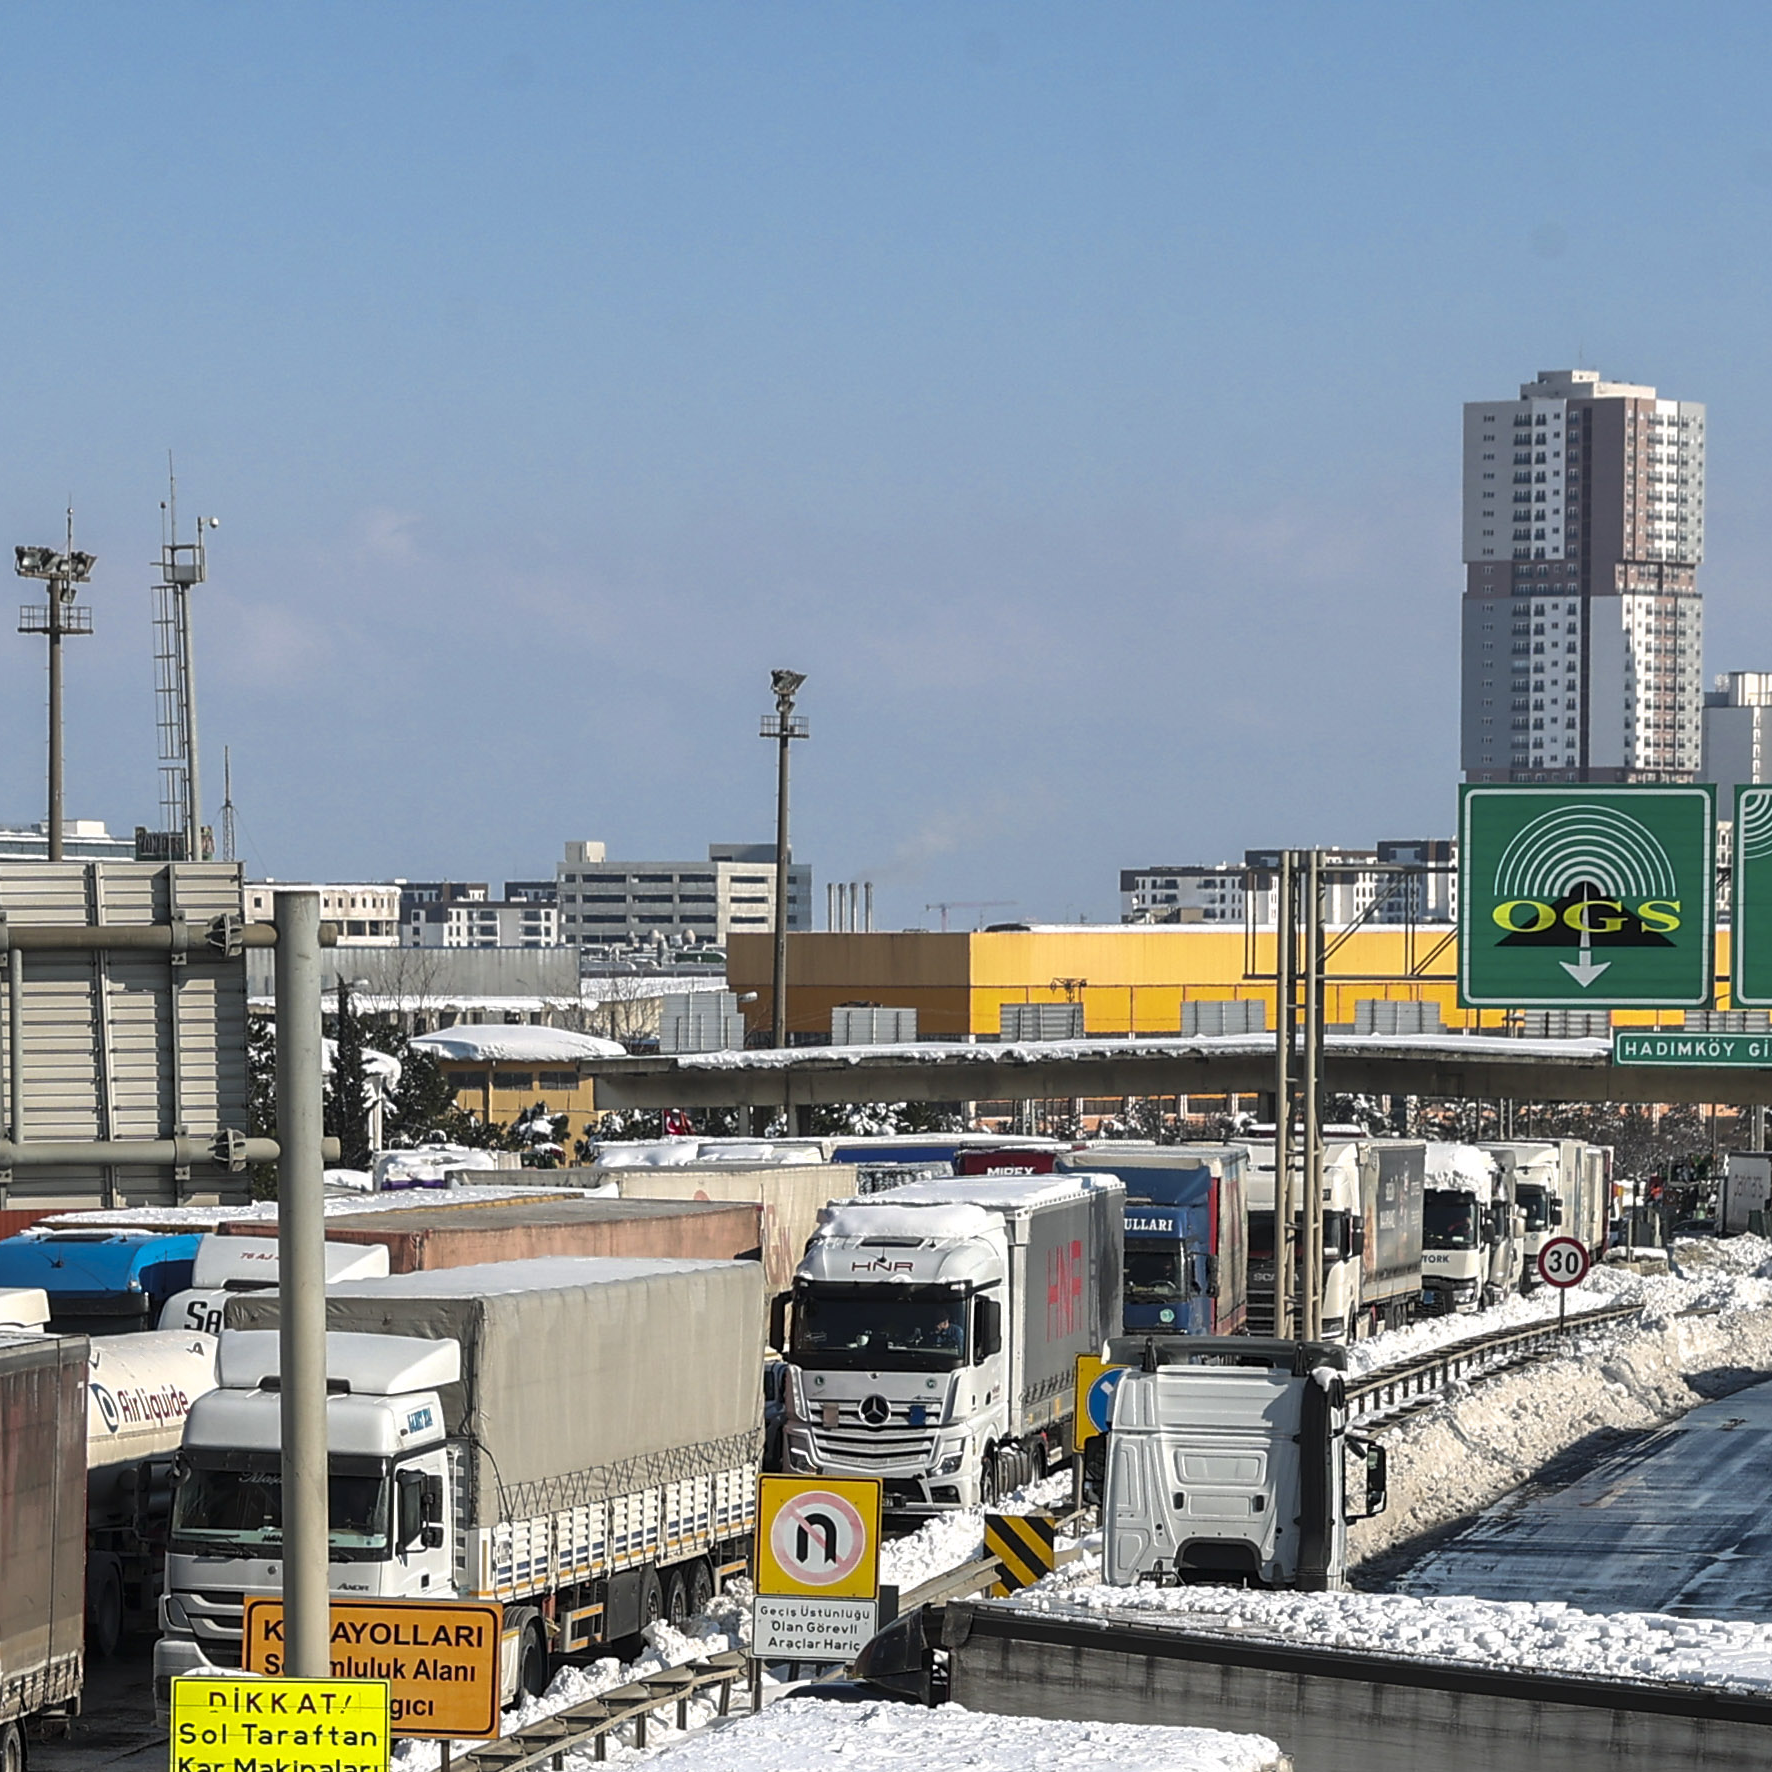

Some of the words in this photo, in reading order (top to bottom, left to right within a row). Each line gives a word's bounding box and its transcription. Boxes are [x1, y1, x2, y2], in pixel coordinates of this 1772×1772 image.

[1492, 900, 1681, 933] OGS
[1625, 1038, 1734, 1057] HADIMKÖY
[1123, 1218, 1174, 1231] ULLARI
[852, 1260, 914, 1272] HNR
[1548, 1249, 1579, 1275] 30
[264, 1619, 483, 1648] KAYOLLARI
[806, 1622, 858, 1635] Görevli
[768, 1636, 821, 1651] Araçlar
[824, 1639, 861, 1652] Hariç
[416, 1657, 476, 1682] Alanı
[179, 1722, 227, 1745] Sol
[241, 1723, 378, 1747] Taraftan
